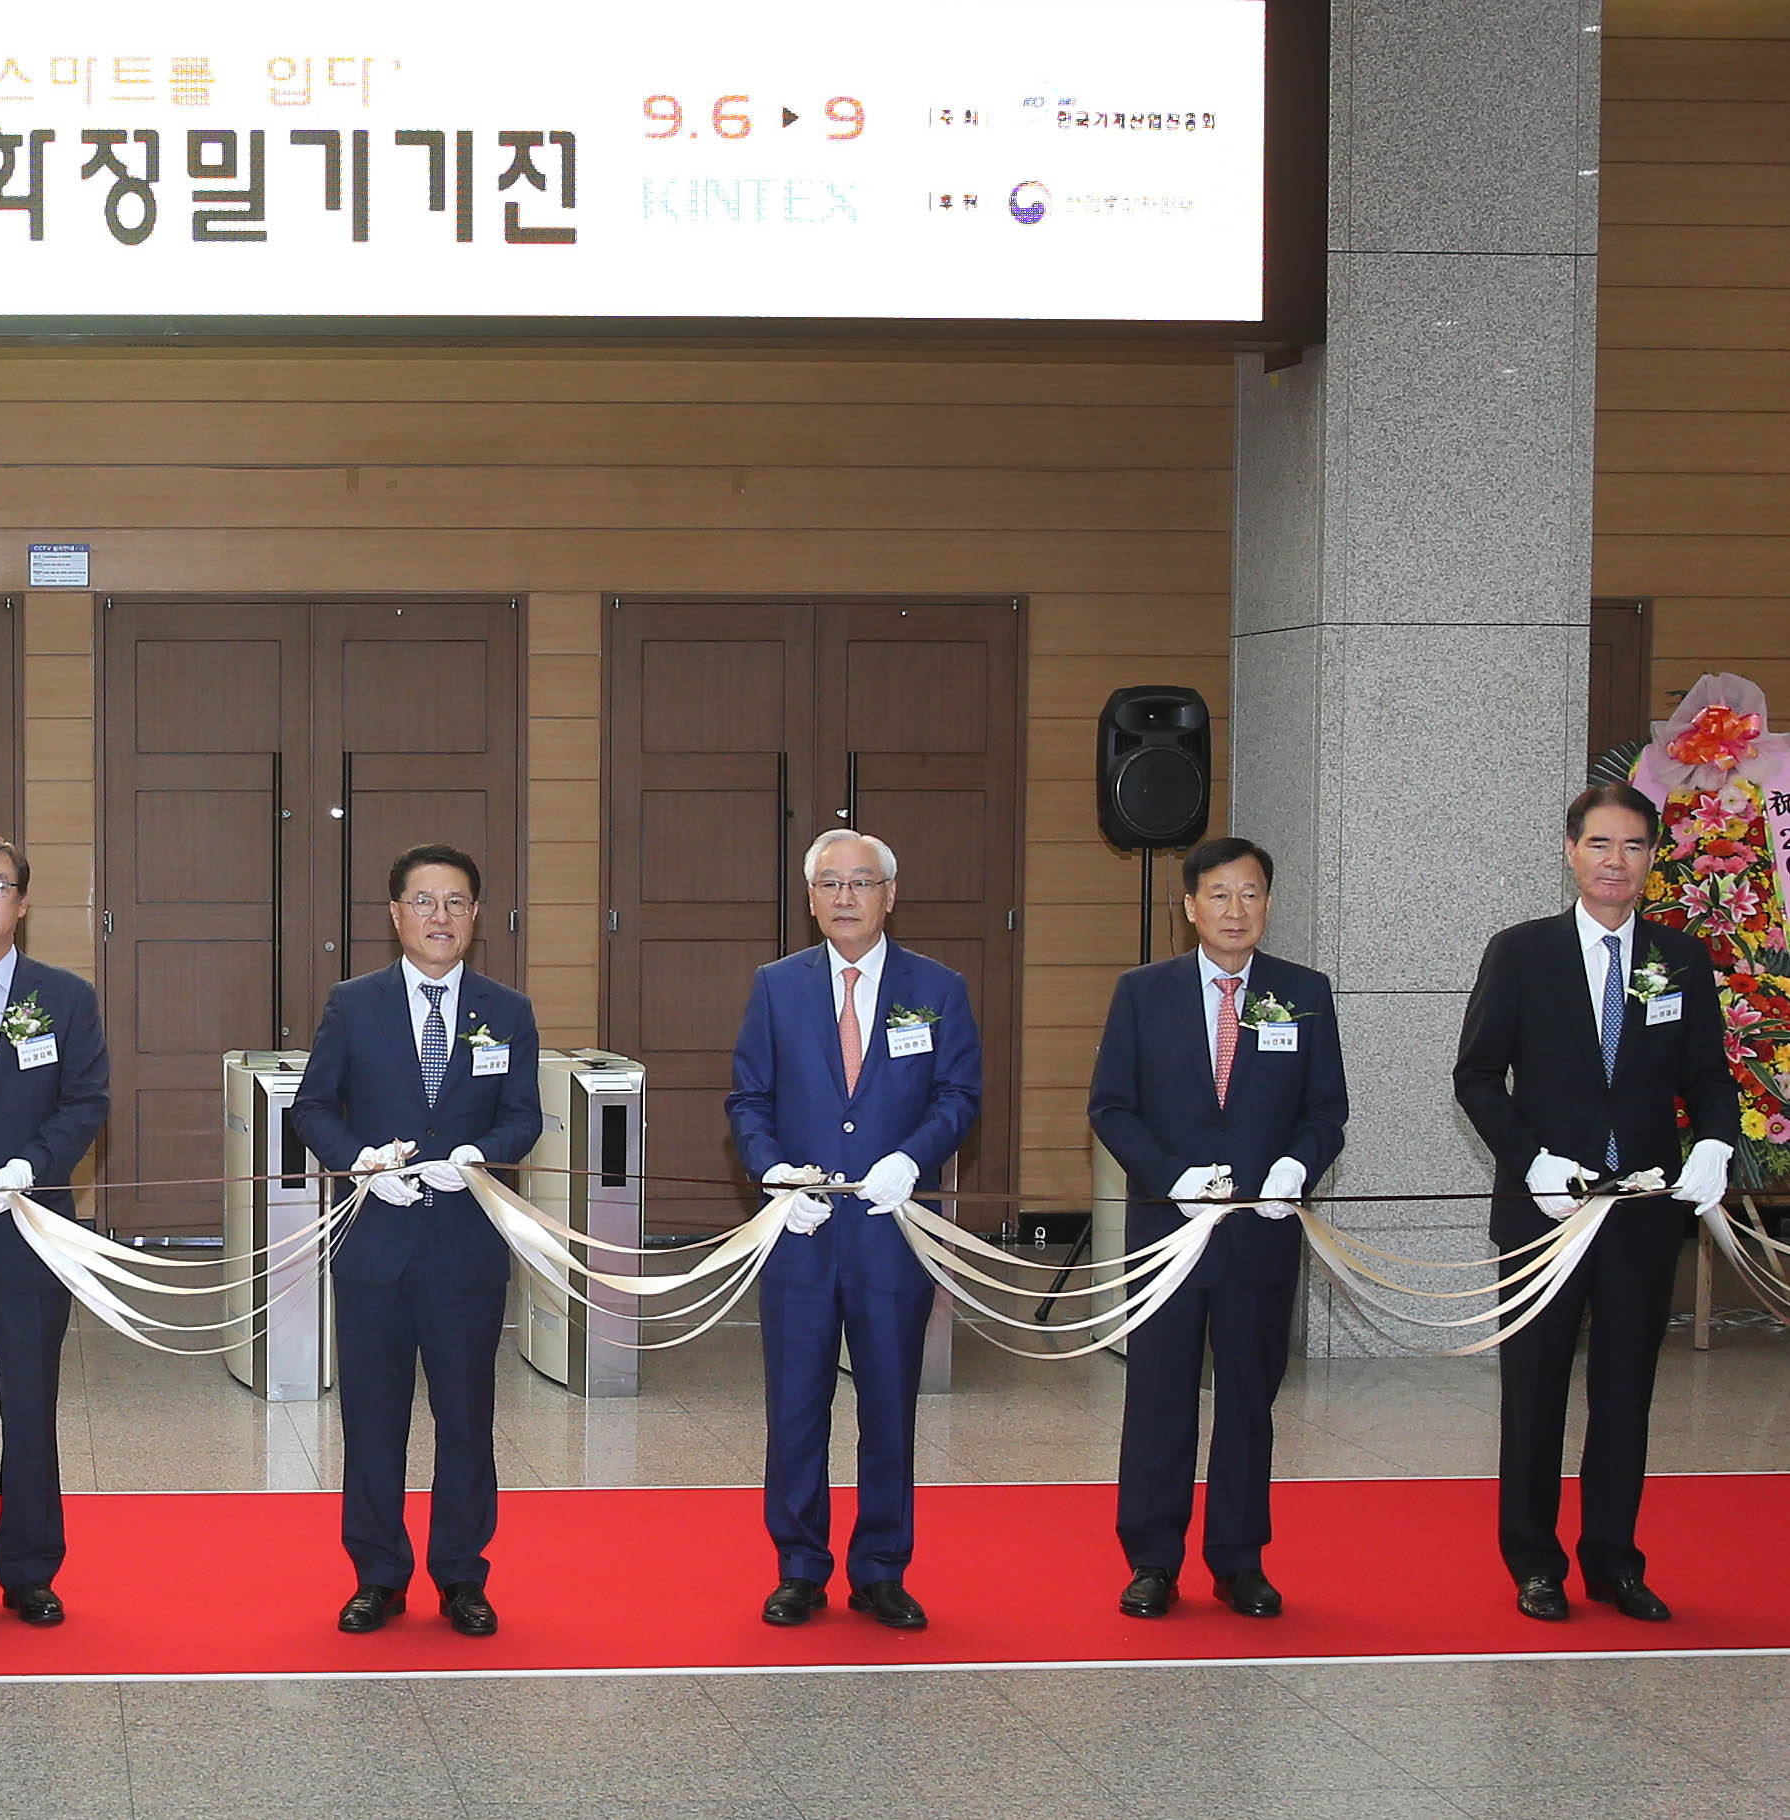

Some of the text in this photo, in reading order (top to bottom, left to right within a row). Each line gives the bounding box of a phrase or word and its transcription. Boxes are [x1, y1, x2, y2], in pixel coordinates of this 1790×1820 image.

[642, 94, 866, 141] 9.6 9
[642, 176, 860, 224] KINTEX
